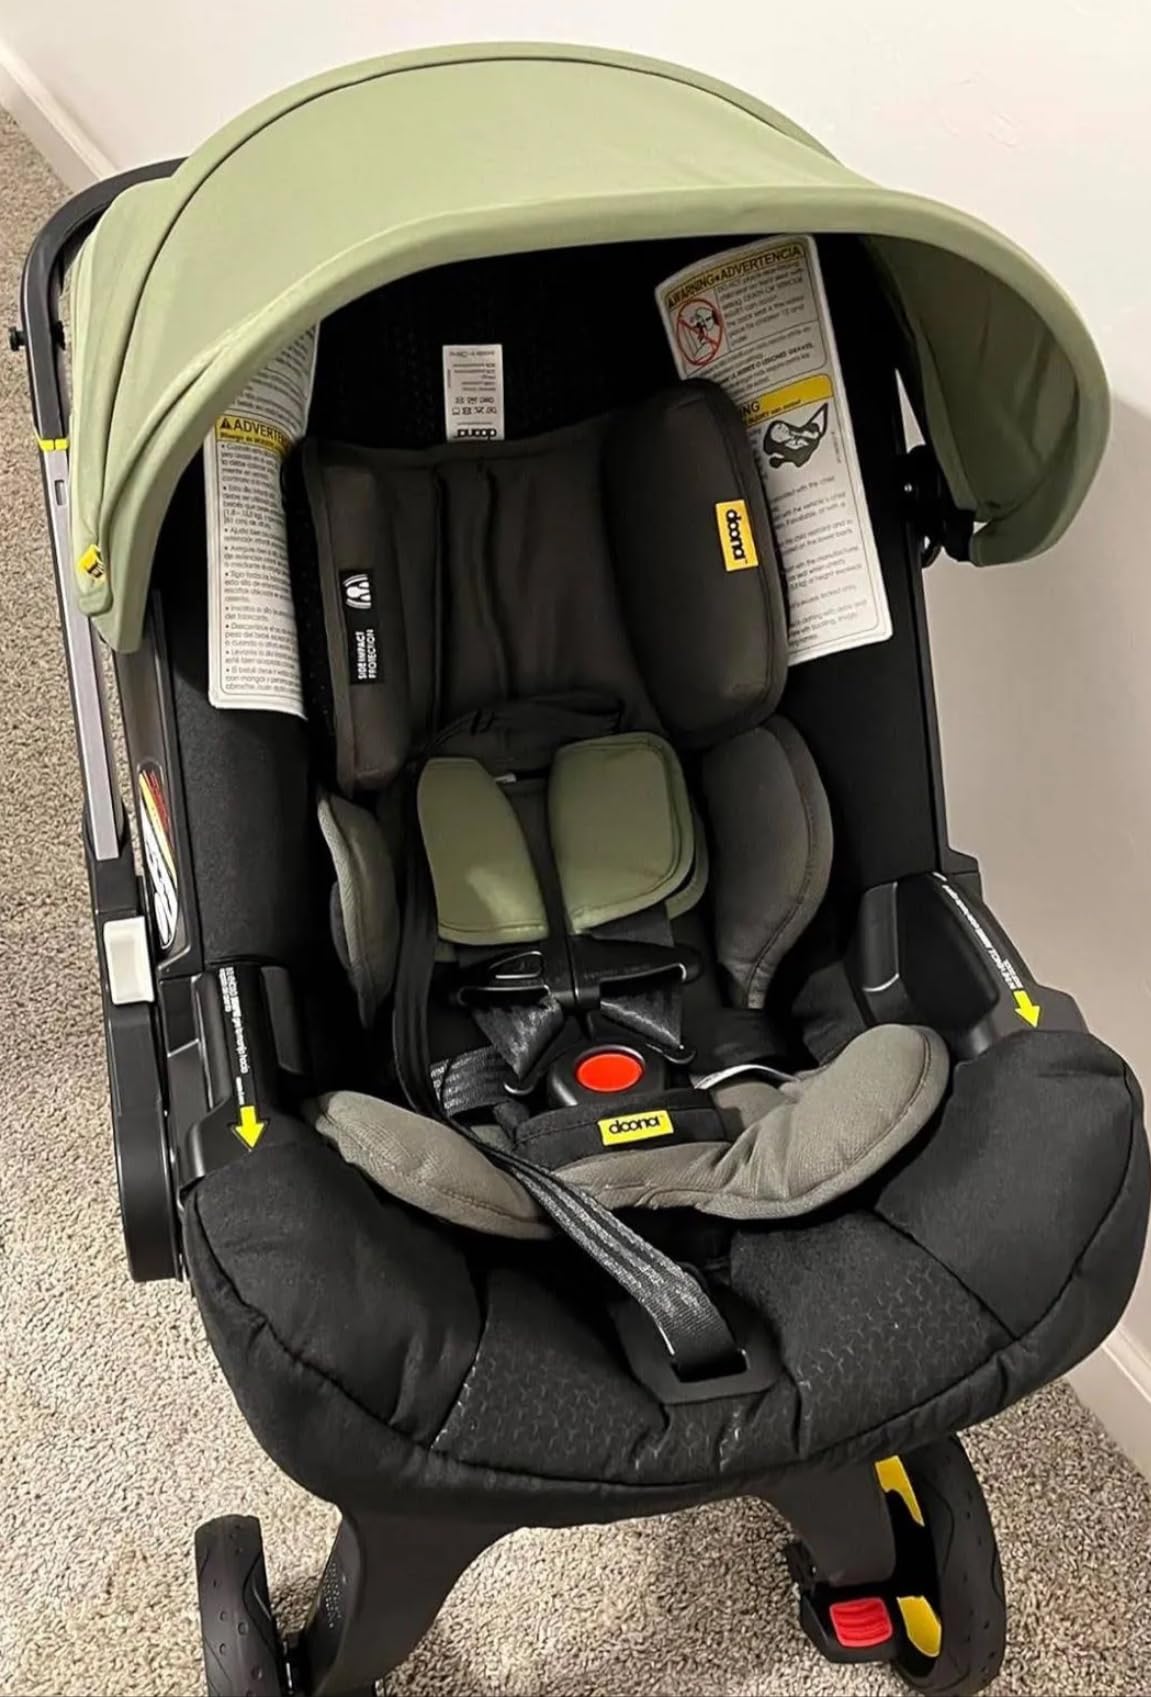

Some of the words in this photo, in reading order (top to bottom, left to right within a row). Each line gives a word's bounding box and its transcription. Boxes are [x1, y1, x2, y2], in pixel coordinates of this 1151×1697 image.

[720, 246, 801, 280] ADVERTENCIA
[726, 509, 746, 560] doona
[355, 631, 366, 662] IMPACT
[366, 629, 377, 679] PROTECTION
[357, 662, 367, 680] SIDE
[609, 1116, 660, 1134] doona
